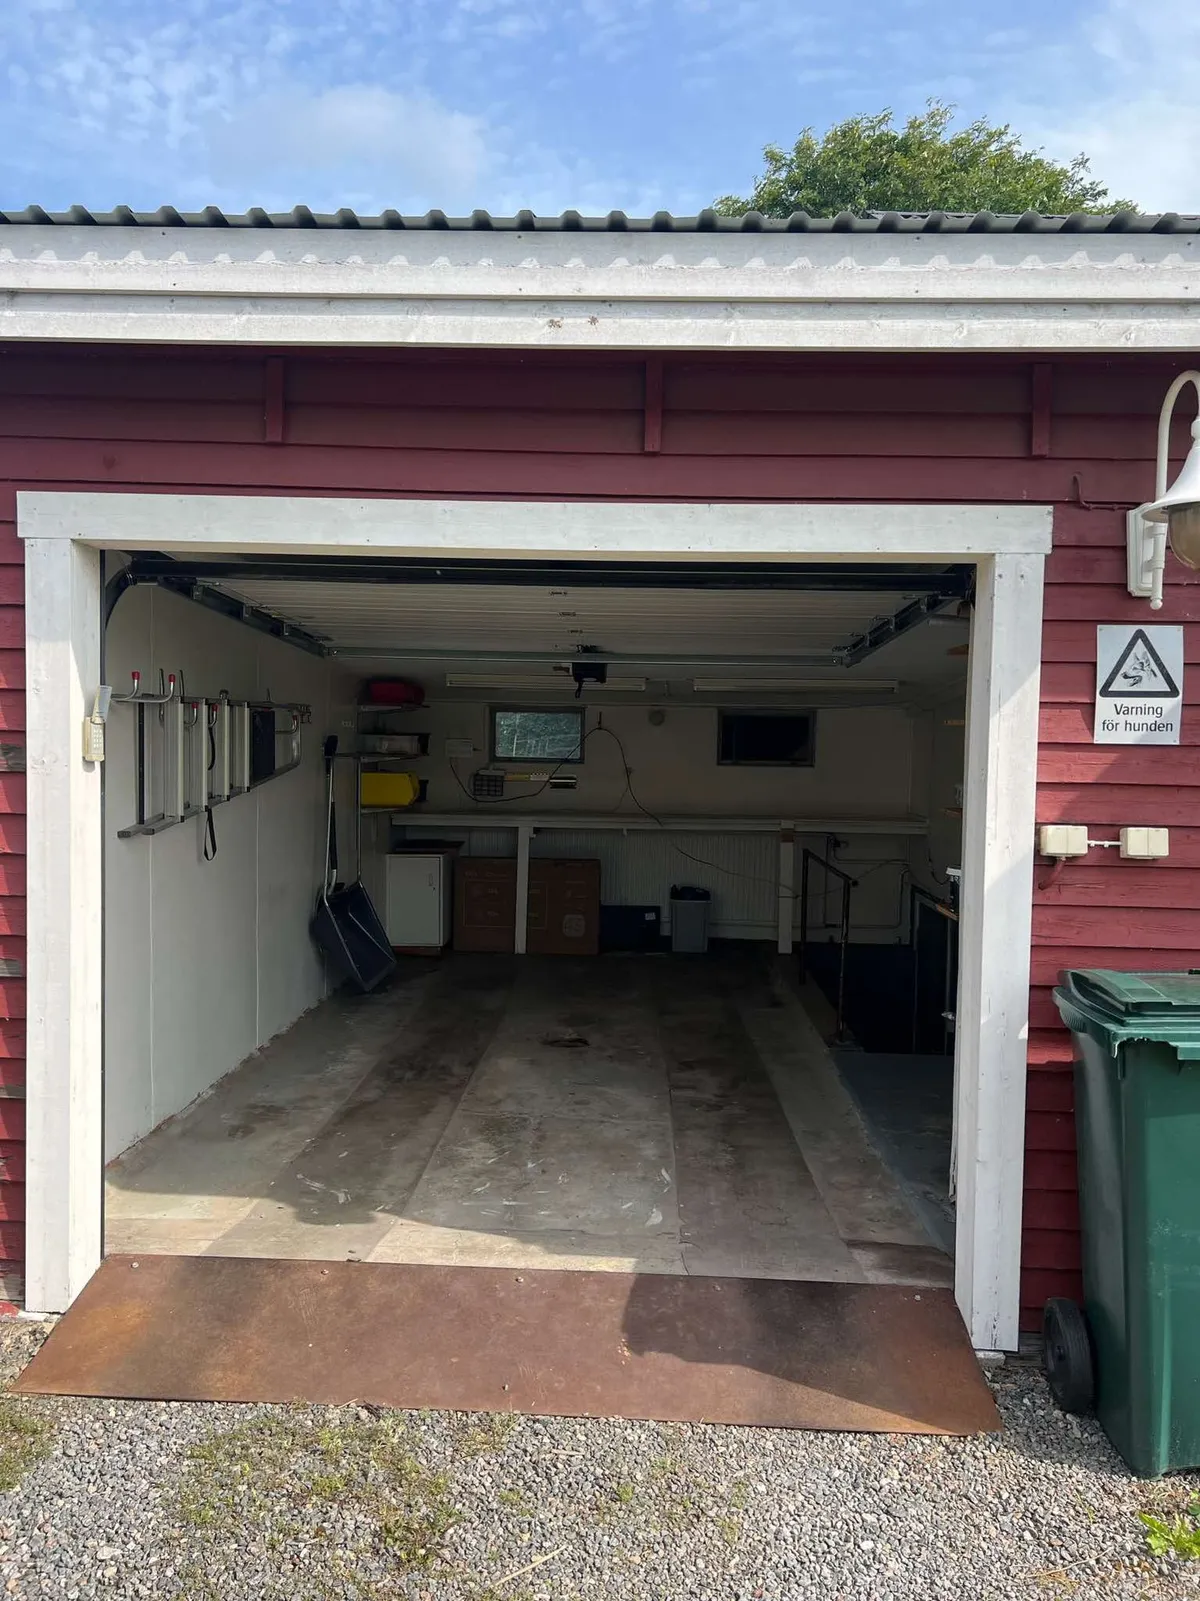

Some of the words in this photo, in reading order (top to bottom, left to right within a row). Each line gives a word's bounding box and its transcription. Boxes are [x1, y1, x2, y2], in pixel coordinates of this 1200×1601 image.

[1114, 704, 1163, 718] Varning
[1102, 720, 1119, 731] för
[1125, 720, 1173, 732] hunden
